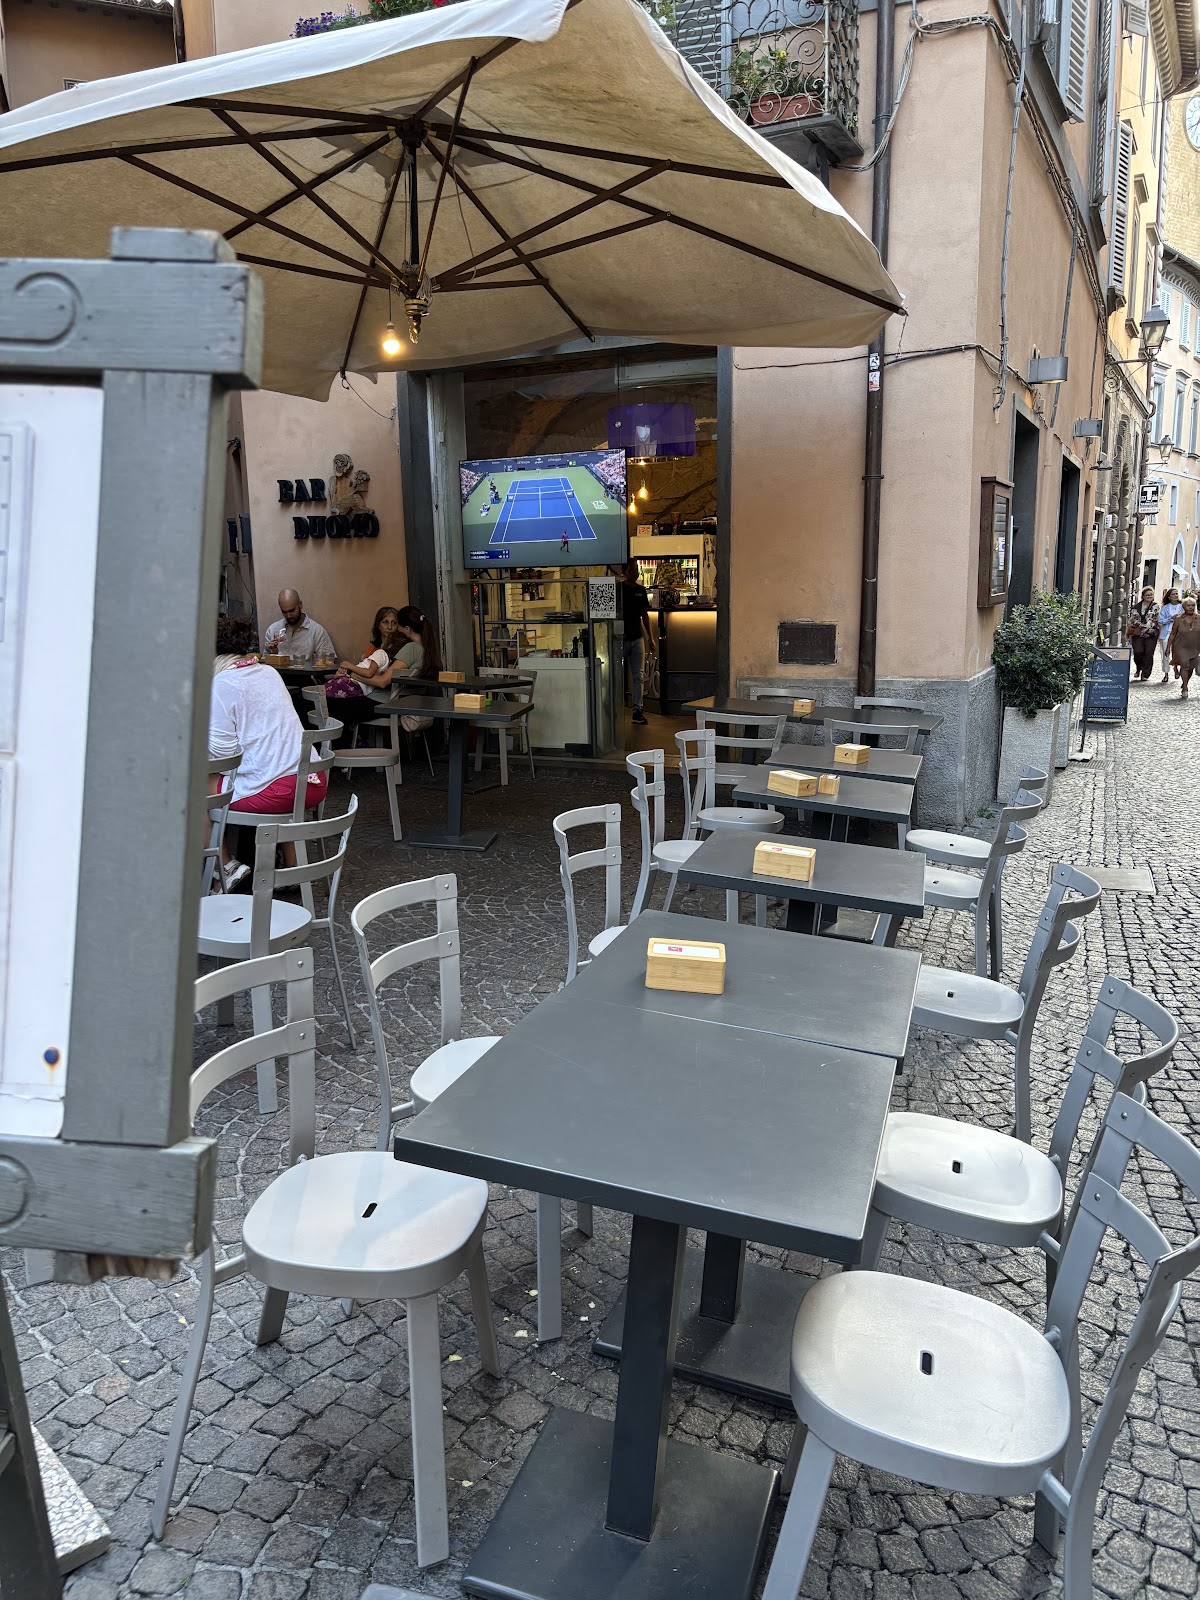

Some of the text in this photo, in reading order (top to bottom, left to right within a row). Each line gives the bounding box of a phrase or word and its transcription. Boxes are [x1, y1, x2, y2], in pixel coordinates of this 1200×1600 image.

[277, 478, 327, 503] BAR
[1143, 487, 1157, 500] T
[293, 513, 380, 539] DUOMO
